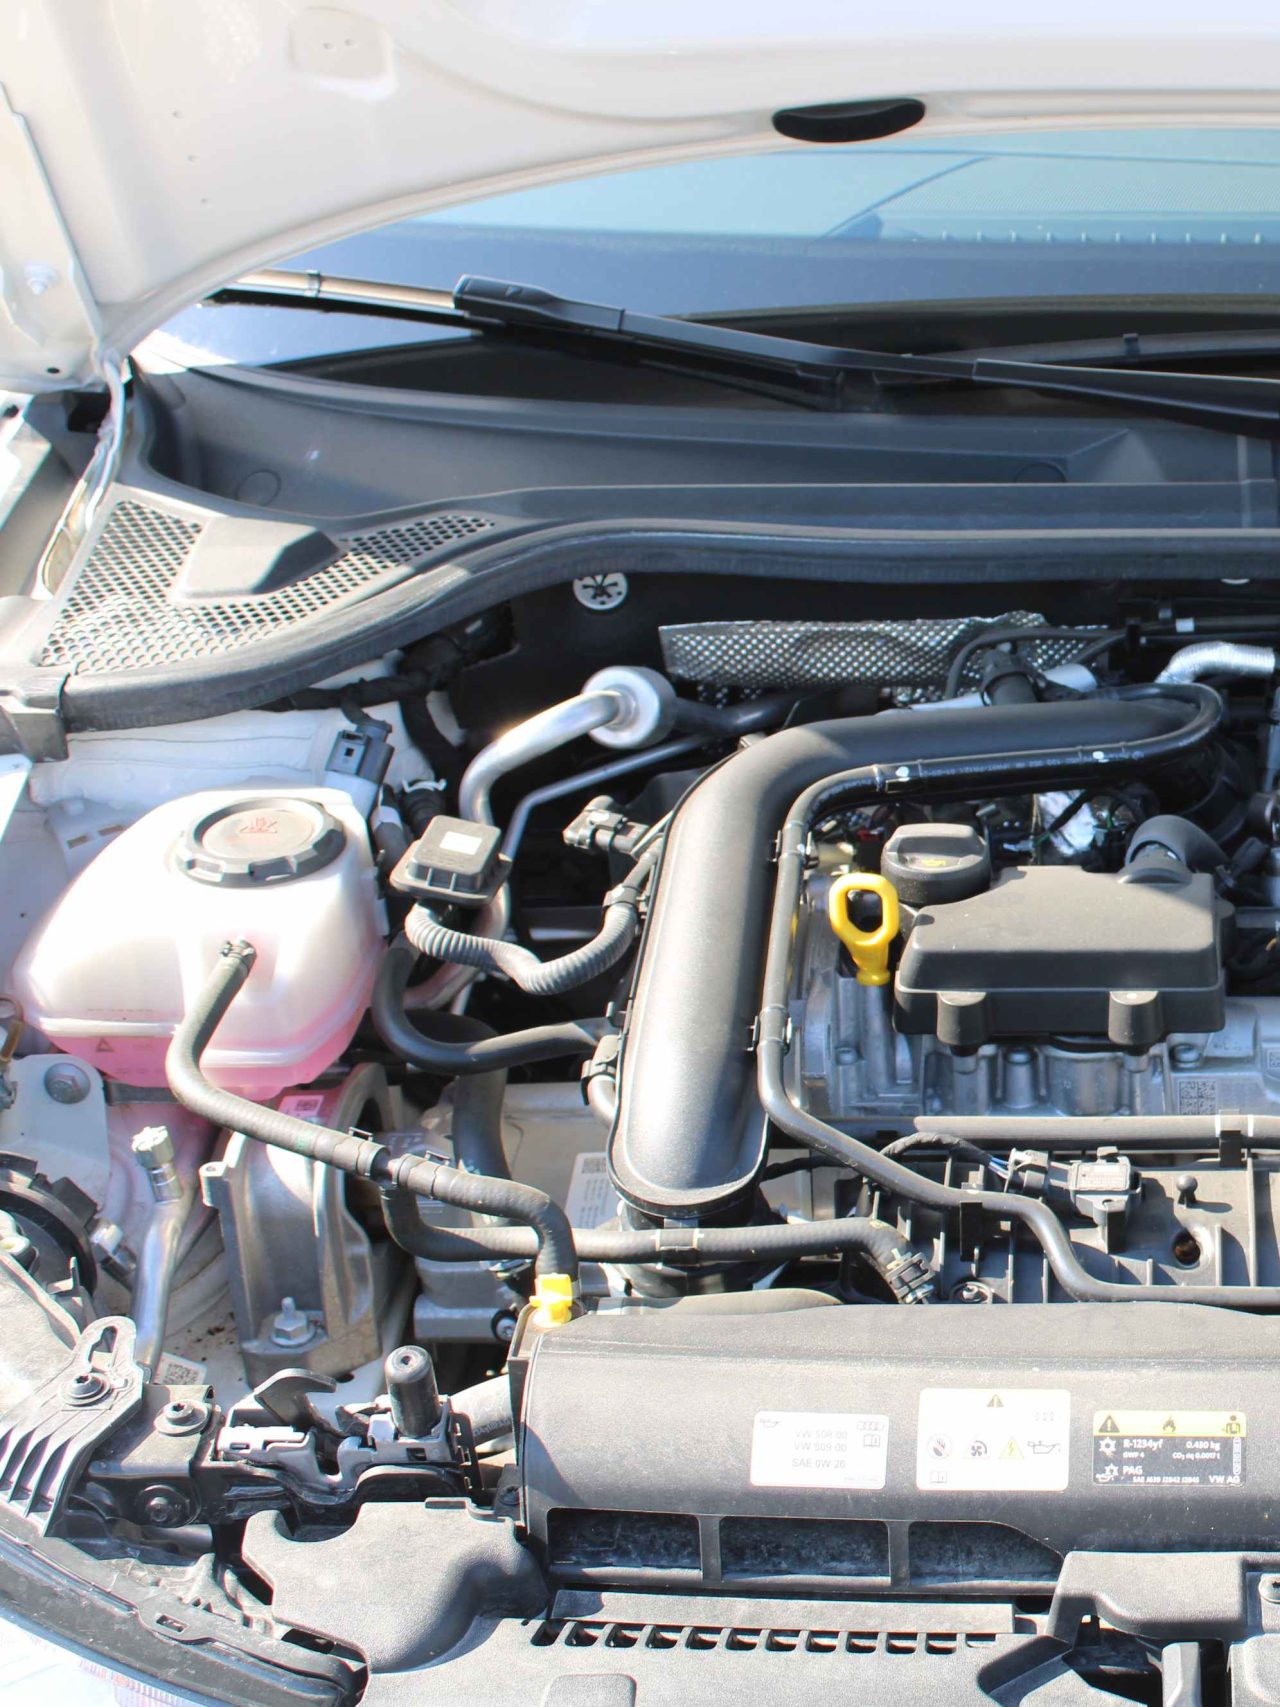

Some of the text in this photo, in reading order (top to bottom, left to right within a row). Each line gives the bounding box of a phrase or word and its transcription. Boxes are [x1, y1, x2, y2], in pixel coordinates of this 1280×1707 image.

[793, 1441, 811, 1451] VW
[835, 1443, 848, 1452] 00
[1123, 1438, 1163, 1451] R-1234yf
[1210, 1441, 1220, 1452] kg
[792, 1457, 812, 1468] SAE
[1122, 1465, 1143, 1475] PAG
[1208, 1475, 1240, 1484] VW AG
